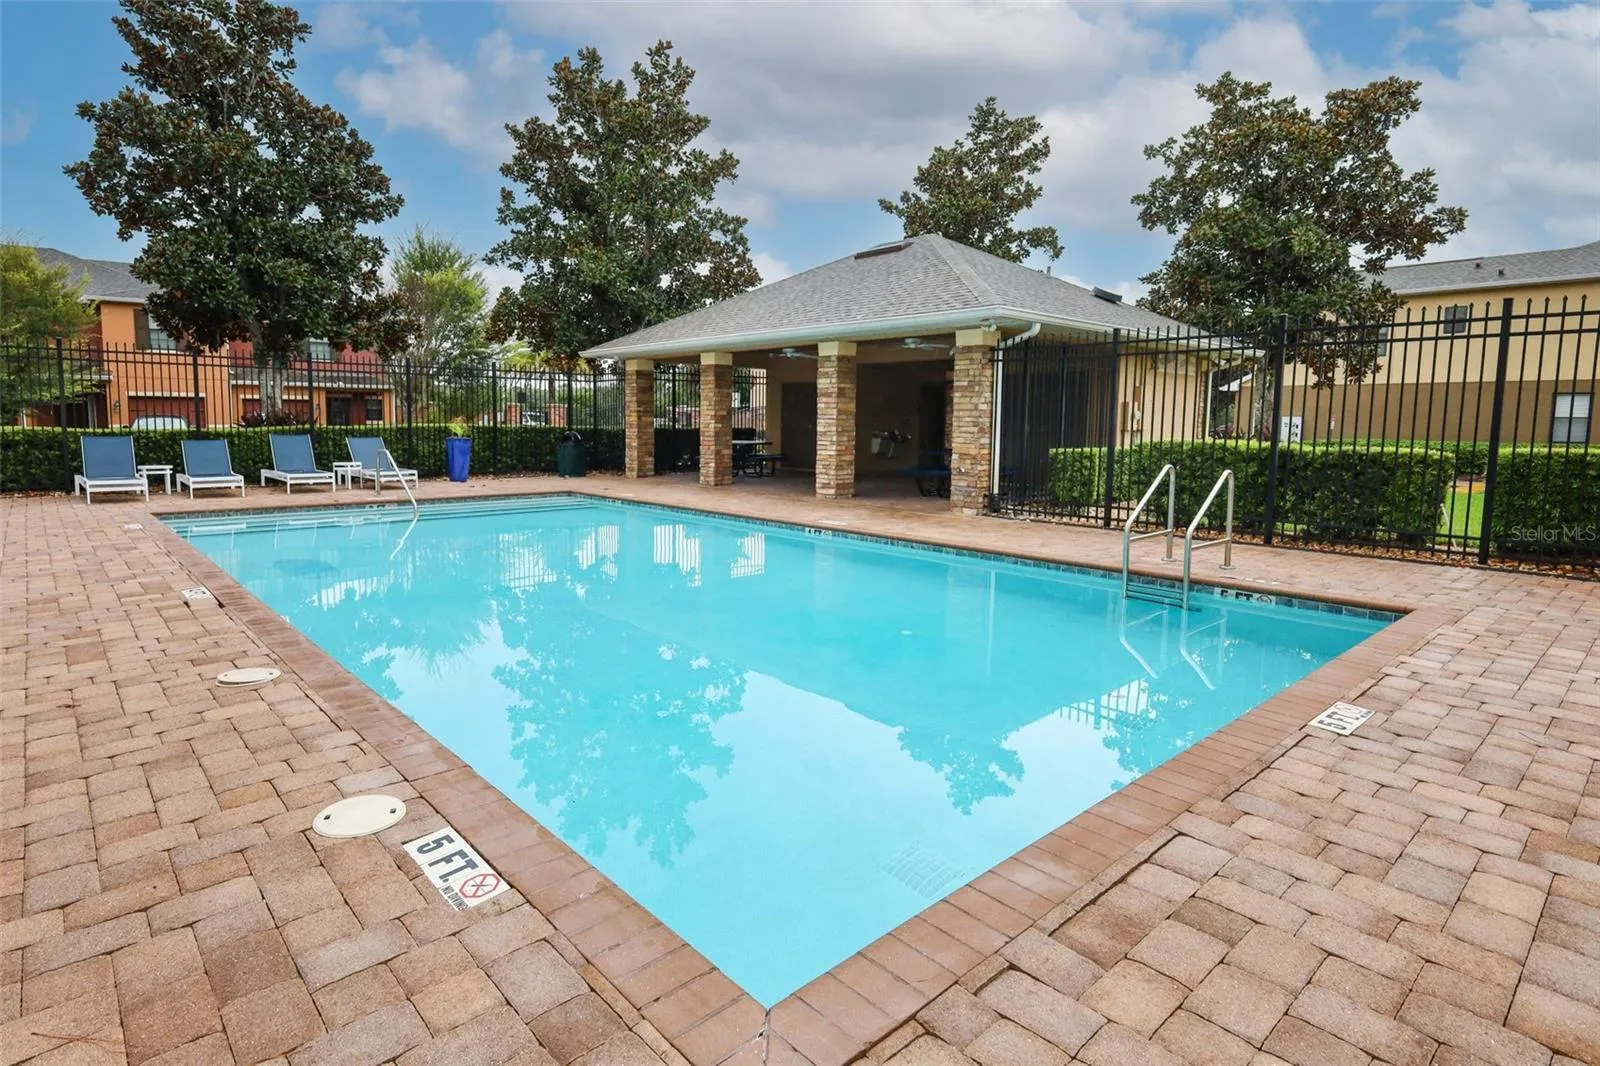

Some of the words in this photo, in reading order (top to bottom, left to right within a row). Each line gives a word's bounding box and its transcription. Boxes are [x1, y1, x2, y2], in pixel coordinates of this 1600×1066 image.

[416, 834, 455, 855] 5
[427, 848, 479, 883] FT.
[440, 885, 455, 896] NO
